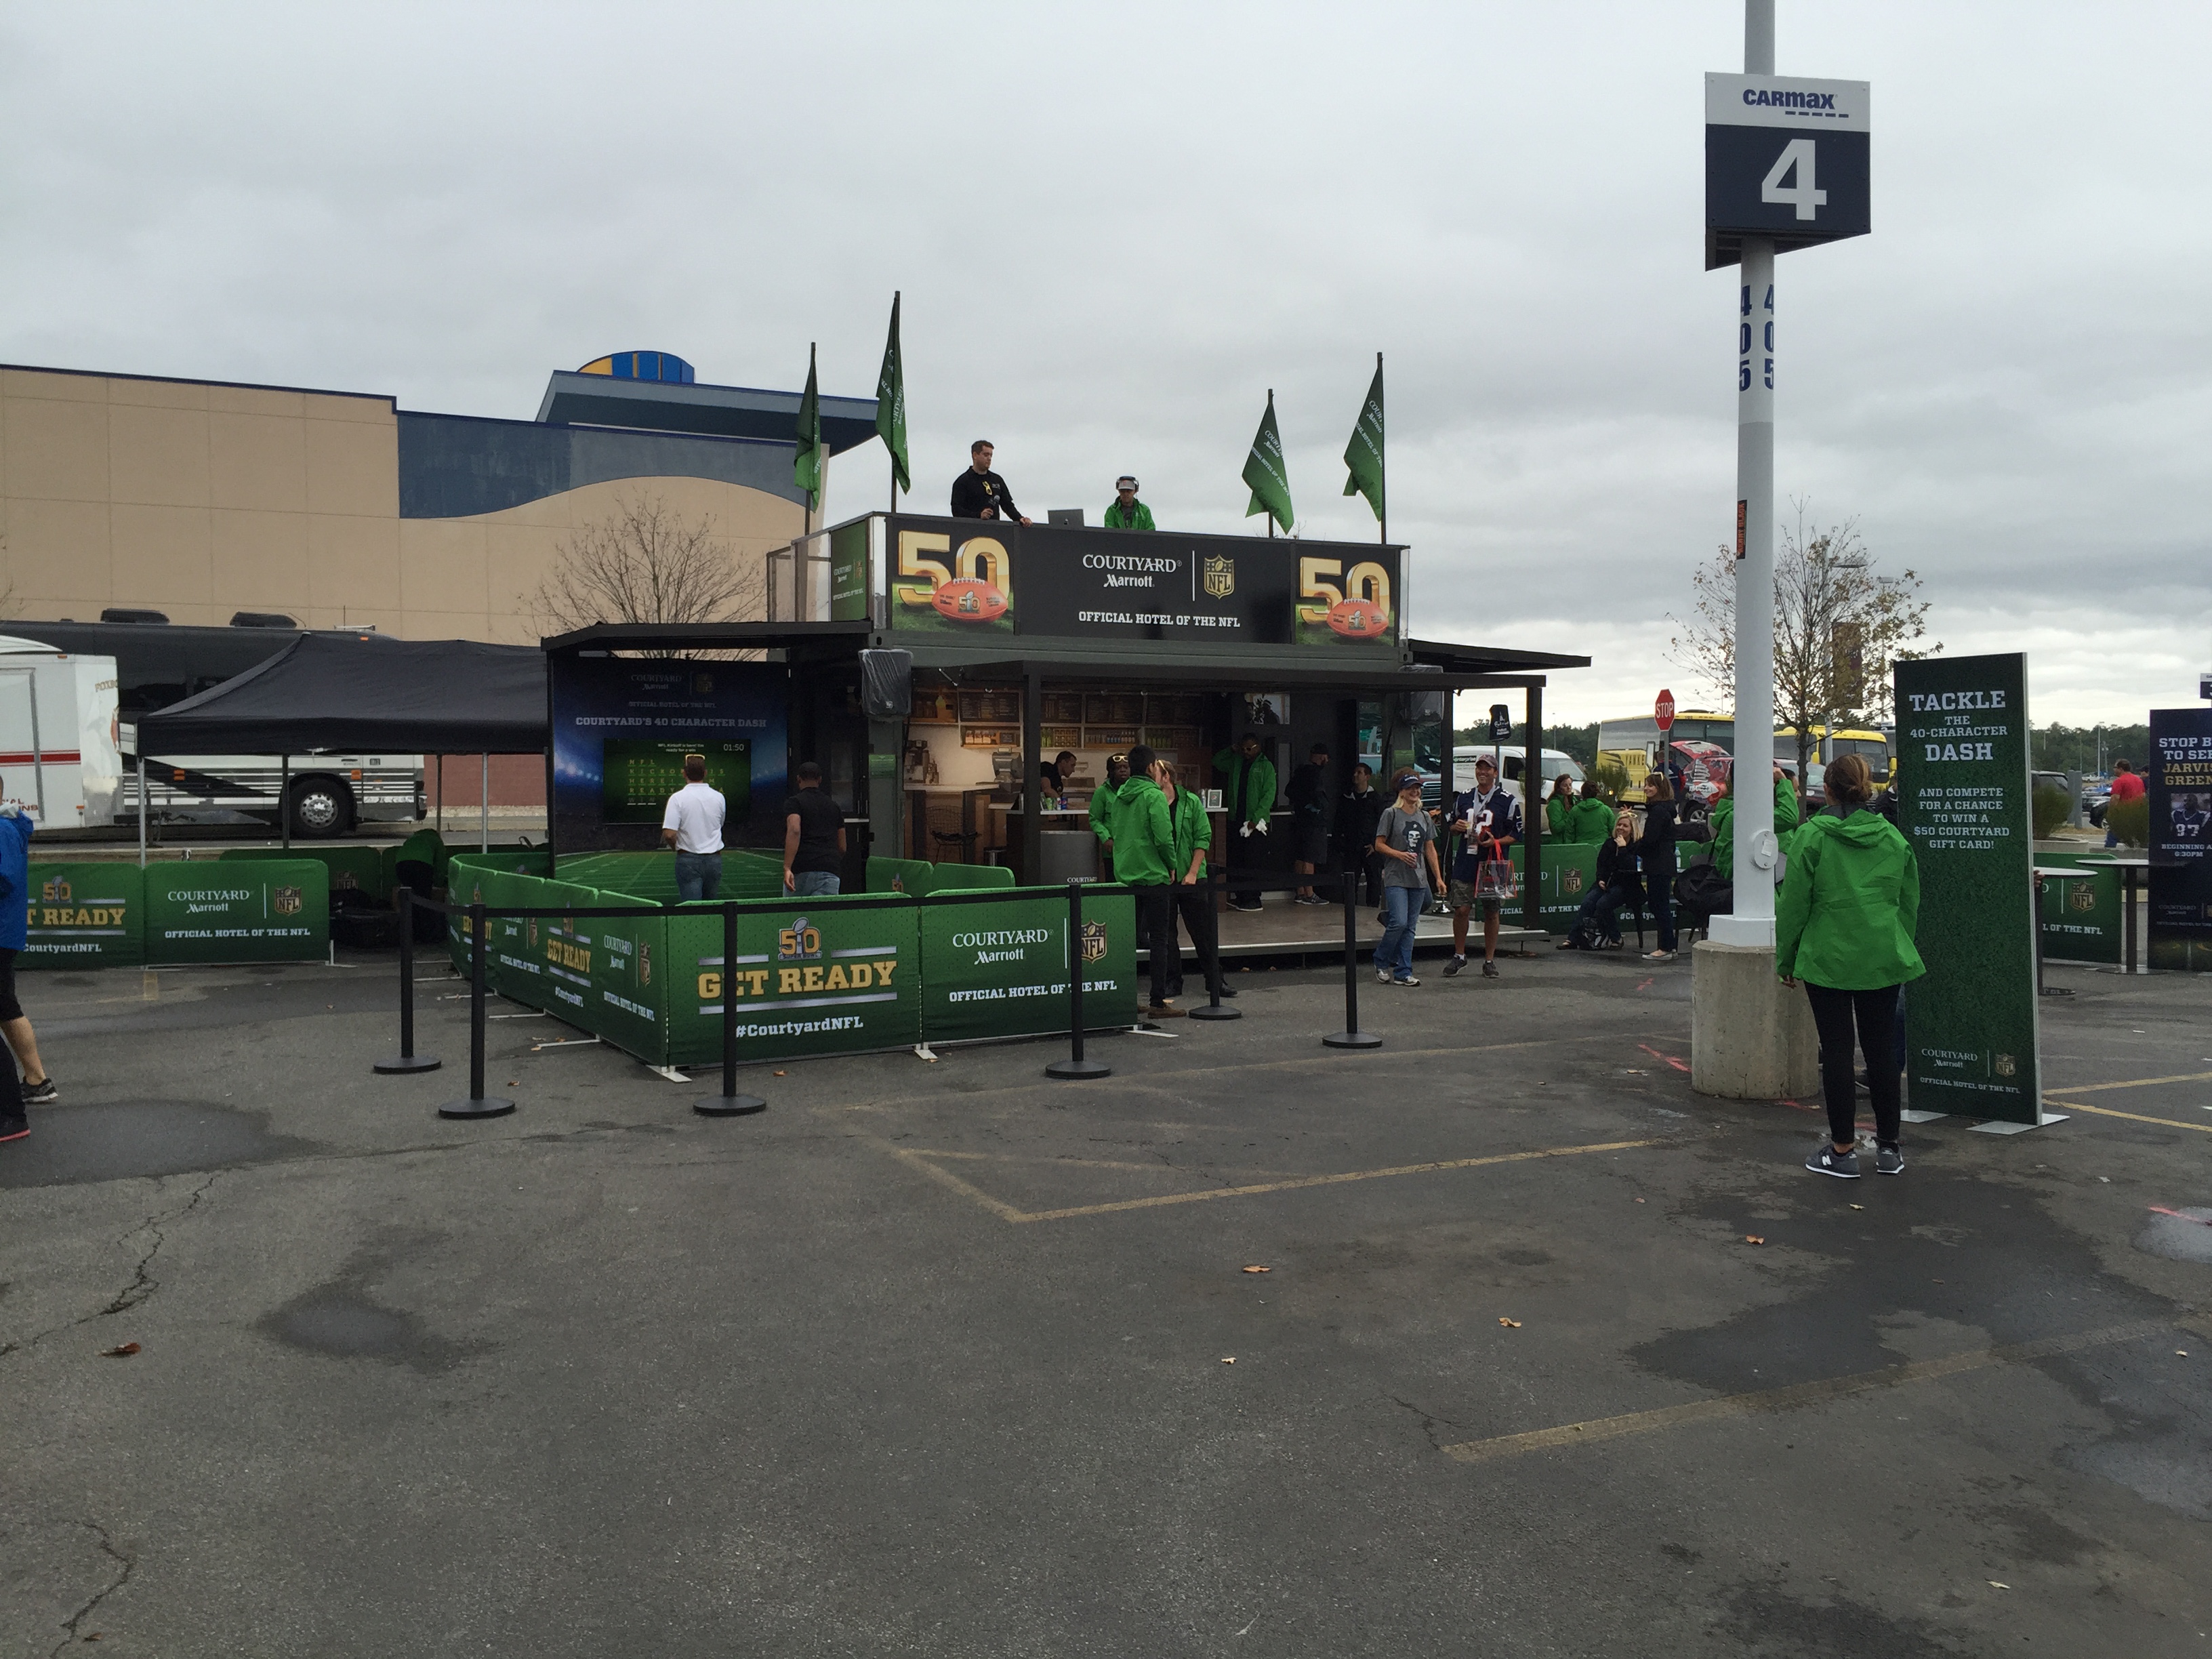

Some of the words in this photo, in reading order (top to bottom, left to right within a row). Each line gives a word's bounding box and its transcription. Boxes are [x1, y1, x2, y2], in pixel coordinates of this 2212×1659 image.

[1761, 139, 1827, 220] 4
[898, 530, 1010, 607] 50
[1082, 554, 1177, 573] COURTYARD
[1103, 574, 1153, 588] Marriott
[1208, 574, 1231, 592] NFL
[1300, 556, 1390, 624] 50
[1078, 611, 1132, 623] OFFICIAL
[1135, 614, 1173, 625] HOTEL
[1176, 615, 1191, 626] OF
[1193, 616, 1216, 627] THE
[1218, 617, 1240, 628] NFL
[1909, 691, 2006, 711] TACKLE
[1656, 702, 1673, 718] STOP
[576, 717, 652, 726] COURTYARD'S
[655, 718, 668, 726] 40
[671, 718, 735, 726] CHARACTER
[737, 719, 766, 727] DASH
[1944, 716, 1970, 725] THE
[1910, 726, 2008, 738] 40-CHARACTER
[2158, 737, 2198, 747] STOP
[1925, 743, 1993, 761] DASH
[2164, 750, 2184, 760] TO
[1919, 789, 1943, 797] AND
[1946, 787, 2003, 797] COMPETE
[1919, 802, 1941, 810] FOR
[1944, 802, 1952, 810] A
[1954, 801, 2003, 810] CHANCE
[1933, 815, 1948, 823] TO
[1952, 814, 1977, 823] WIN
[1980, 815, 1989, 823] A
[1914, 826, 1935, 836] $50
[1938, 827, 2010, 836] COURTYARD
[1929, 840, 1955, 848] GIFT
[1959, 840, 1994, 849] CARD!
[1566, 879, 1579, 888] NFL
[43, 882, 72, 901] 50
[167, 890, 249, 901] COURTYARD
[278, 898, 299, 911] NFL
[2074, 893, 2092, 907] NFL
[186, 903, 228, 914] Marriott
[43, 908, 126, 926] READY
[165, 930, 213, 938] OFFICIAL
[215, 929, 249, 937] HOTEL
[251, 928, 264, 937] OF
[290, 928, 310, 936] NFL
[2064, 925, 2083, 933] THE
[2084, 926, 2103, 935] NFL
[779, 926, 821, 955] 50
[952, 929, 1048, 947] COURTYARD
[23, 943, 102, 954] CourtyardNFL
[604, 935, 632, 956] COURTYARD
[1082, 938, 1104, 957] NFL
[547, 939, 562, 962] GET
[563, 943, 591, 973] READY
[975, 948, 1024, 965] Marriott
[779, 961, 897, 994] READY
[949, 988, 1006, 1002] OFFICIAL
[1008, 985, 1048, 998] HOTEL
[1050, 984, 1065, 994] OF
[1094, 981, 1117, 991] NFL
[736, 1016, 864, 1038] #CourtyardNFL
[1921, 1048, 1978, 1061] COURTYARD
[1933, 1059, 1963, 1068] Marriott
[1997, 1063, 2013, 1073] NFL
[1920, 1077, 1952, 1086] OFFICIAL
[1953, 1080, 1977, 1090] HOTEL
